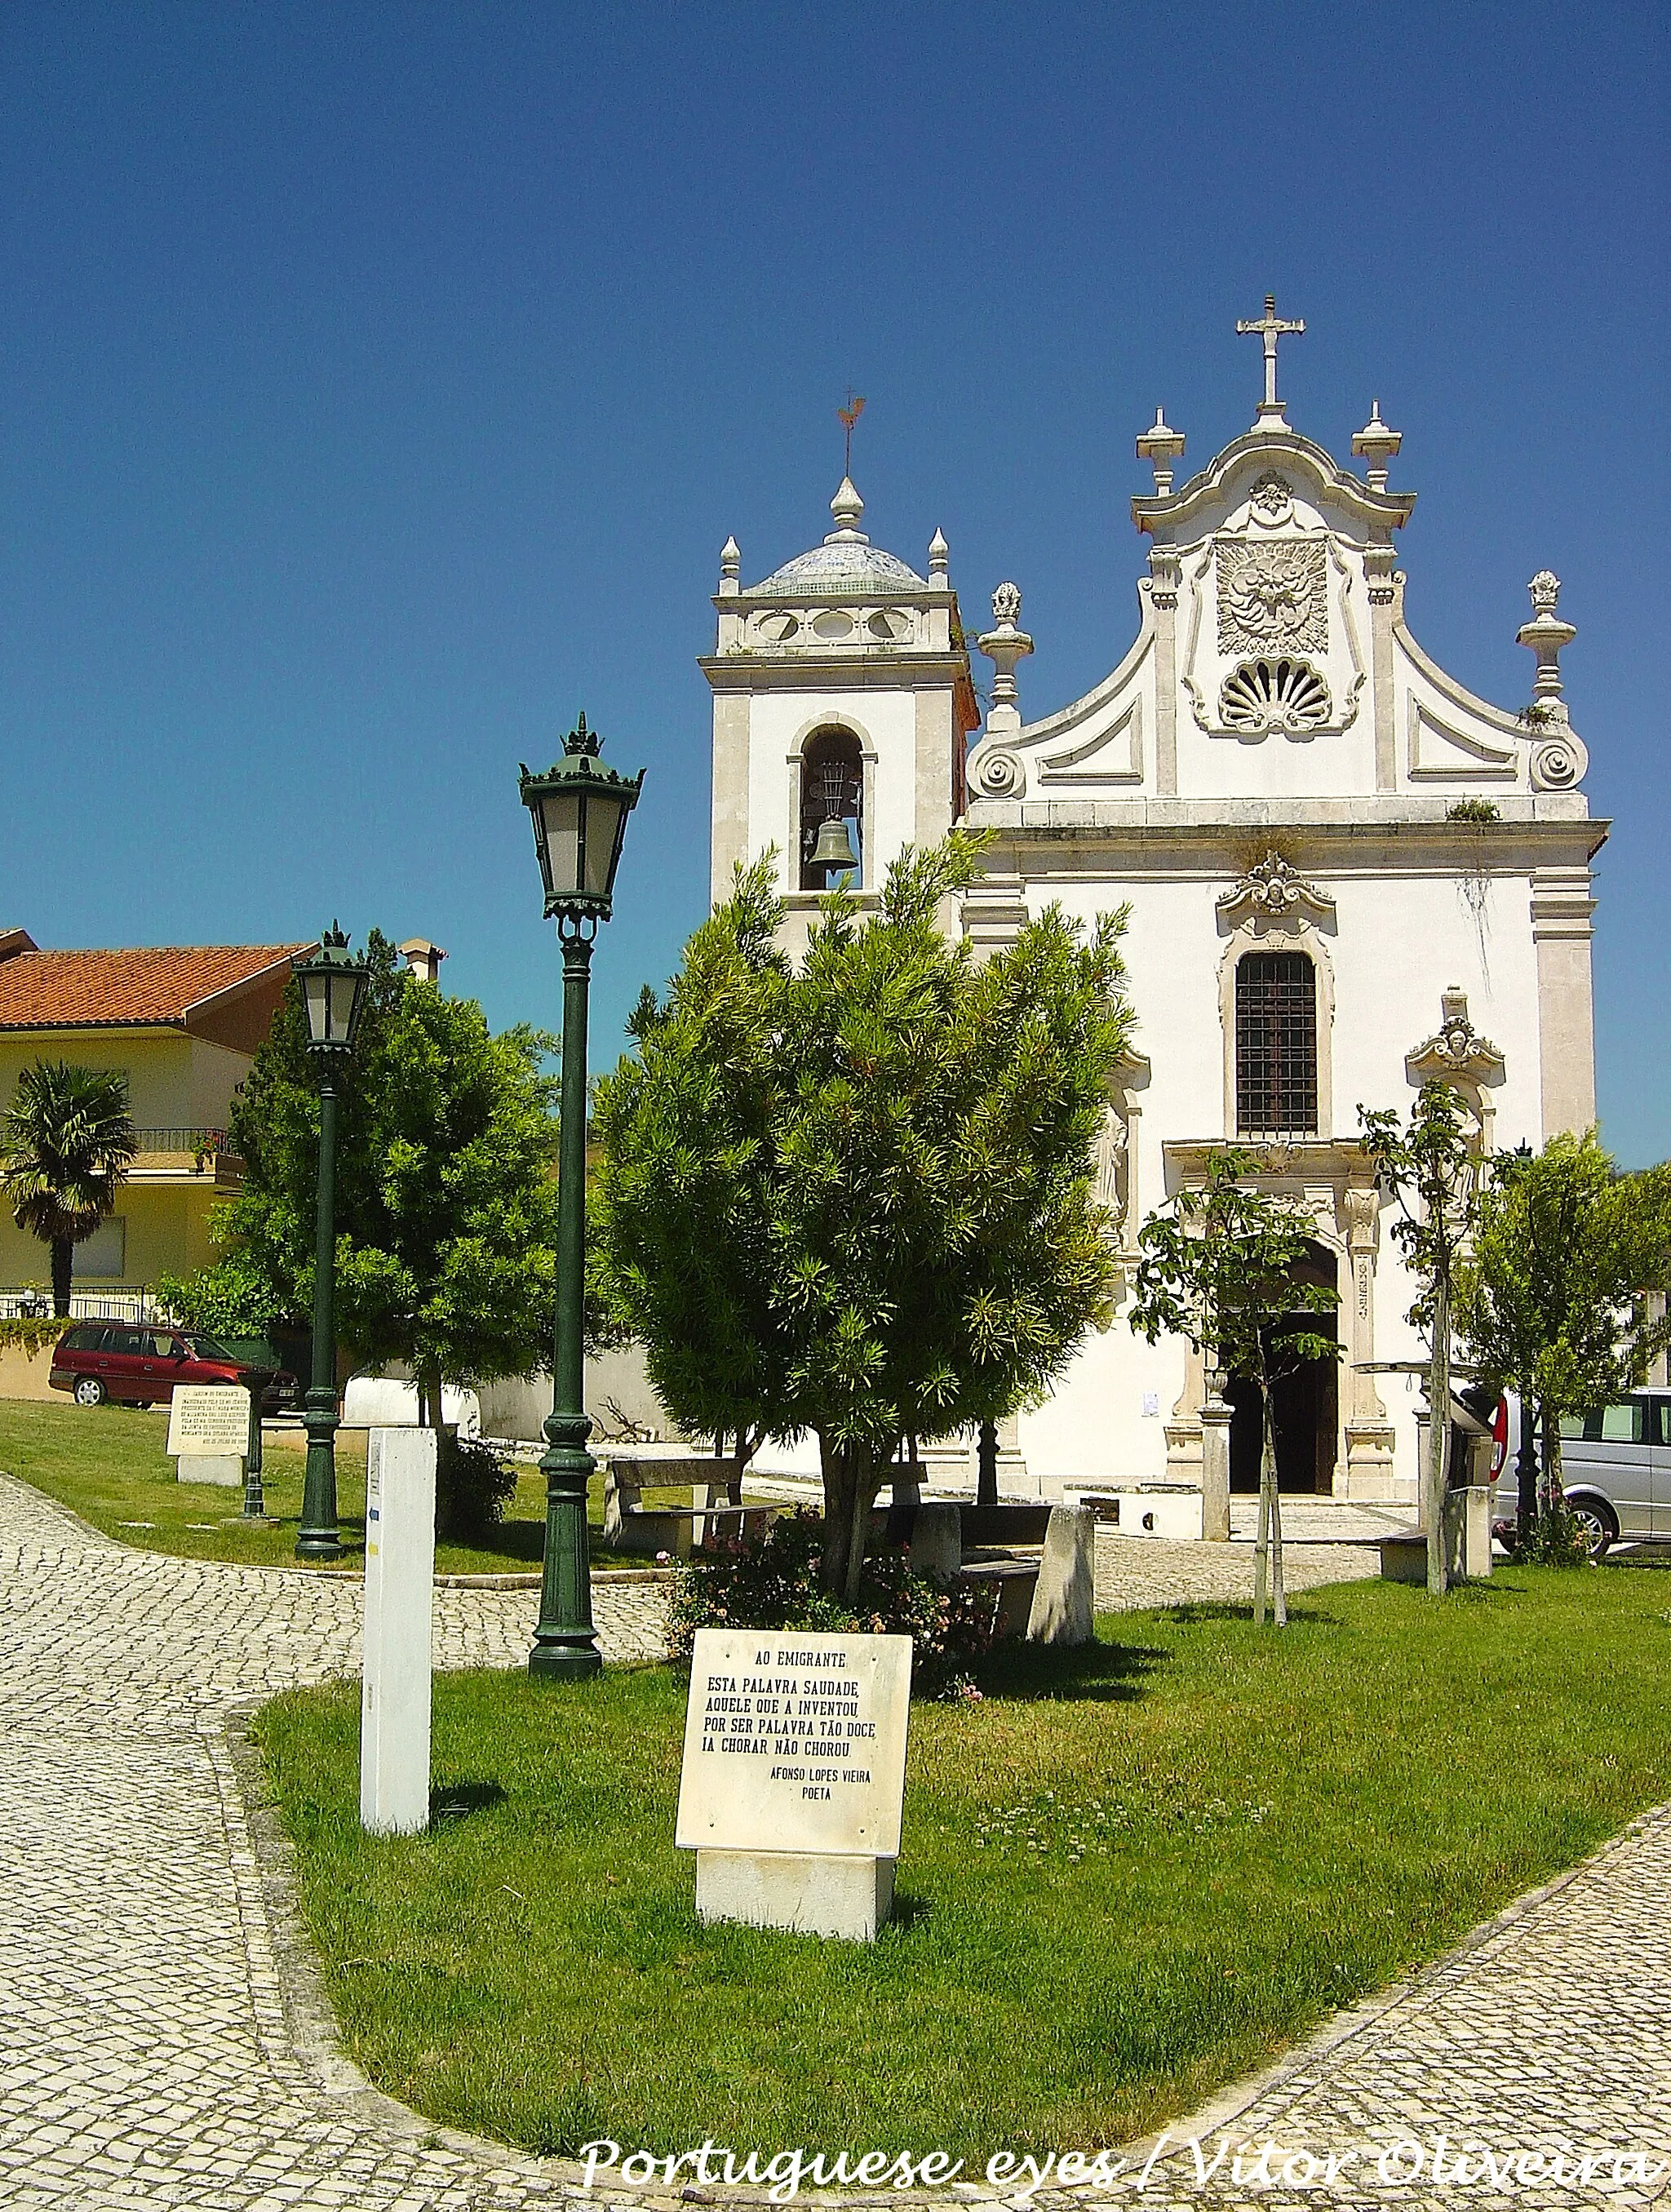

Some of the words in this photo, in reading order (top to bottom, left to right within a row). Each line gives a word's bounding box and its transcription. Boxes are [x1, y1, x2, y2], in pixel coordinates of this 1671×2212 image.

[755, 1651, 770, 1665] AO
[707, 1677, 736, 1692] ESTA
[742, 1678, 798, 1695] PALAVRA
[804, 1680, 859, 1698] SAUDADE,
[705, 1697, 751, 1713] AQUELE
[756, 1699, 779, 1713] QUE
[784, 1700, 792, 1714] A
[798, 1700, 859, 1718] INVENTOU,
[703, 1717, 726, 1732] POR
[731, 1718, 753, 1733] SER
[758, 1719, 814, 1735] PALAVRA
[820, 1720, 842, 1736] TÃO
[702, 1736, 715, 1752] IA
[774, 1739, 798, 1755] NÃO
[770, 1766, 805, 1781] AFONSO
[809, 1768, 839, 1782] LOPES
[843, 1770, 871, 1783] VIEIRA
[802, 1787, 831, 1800] POETA
